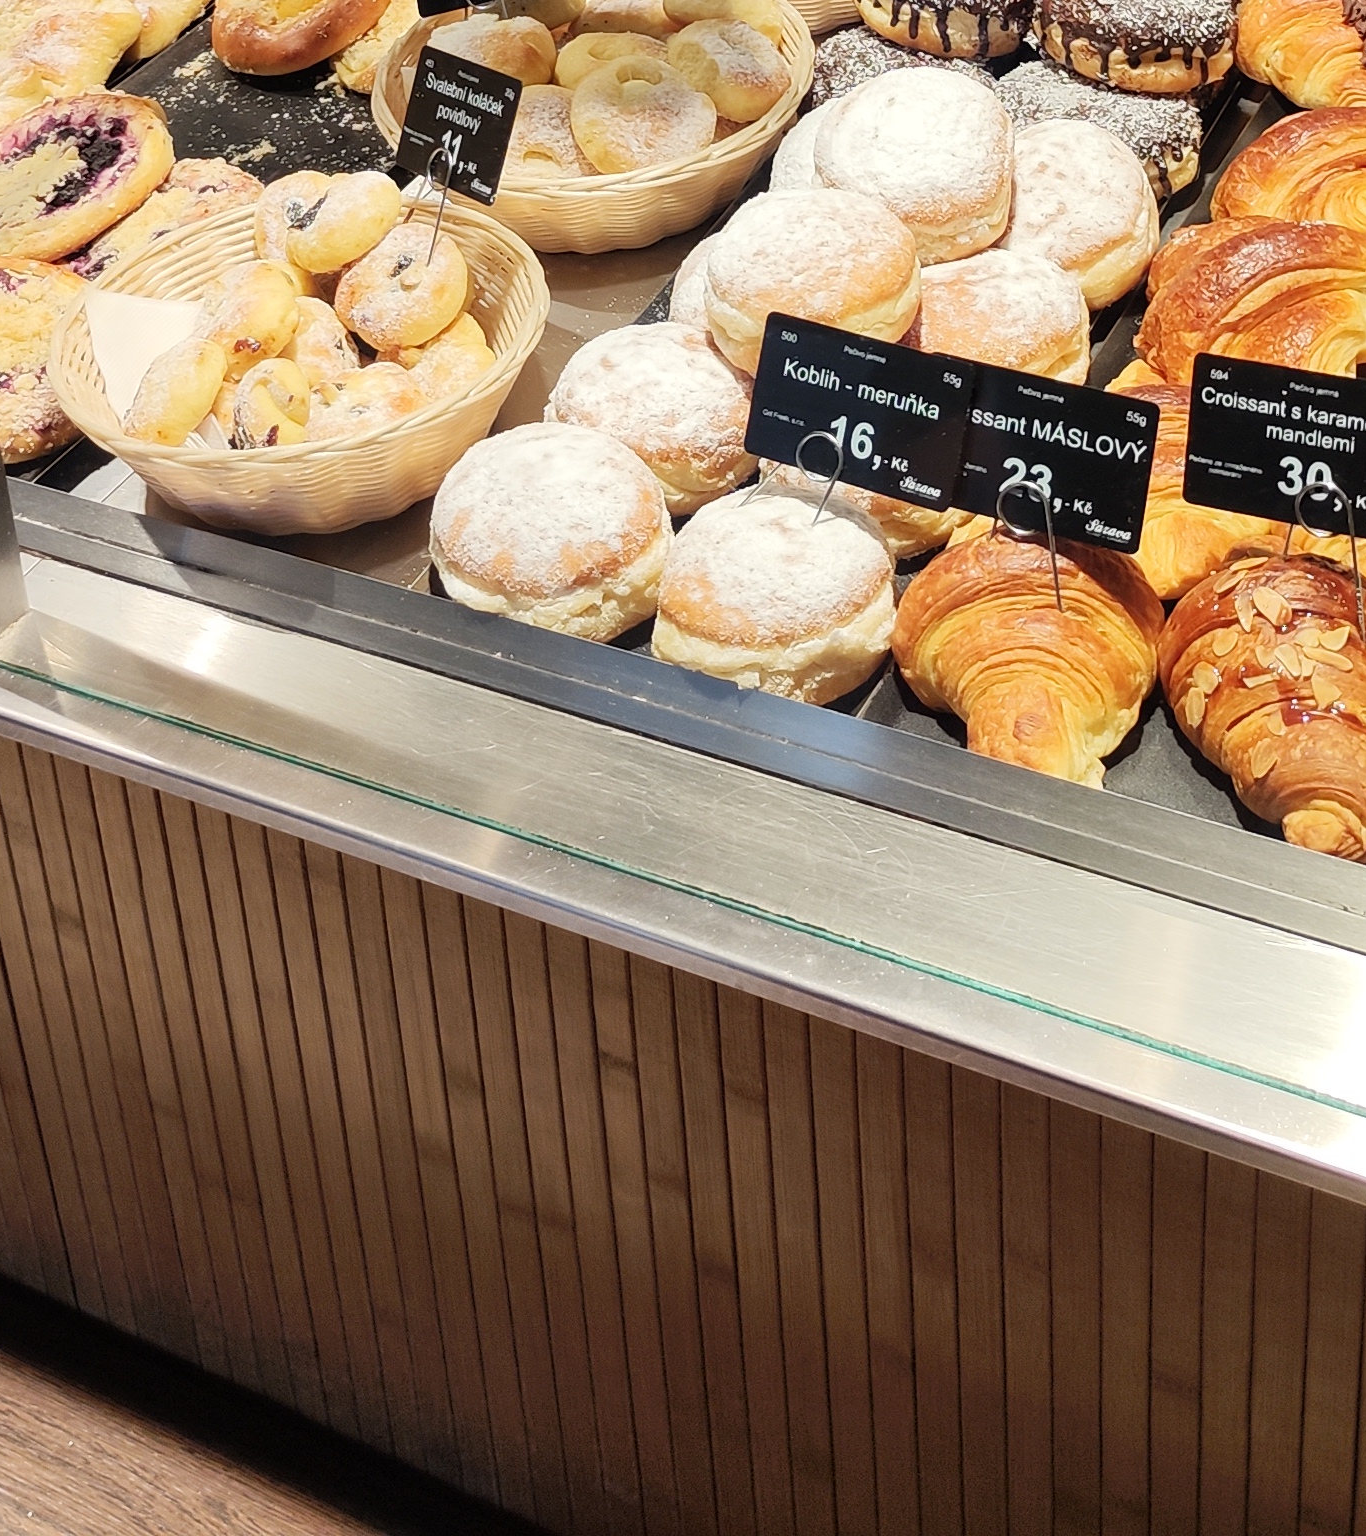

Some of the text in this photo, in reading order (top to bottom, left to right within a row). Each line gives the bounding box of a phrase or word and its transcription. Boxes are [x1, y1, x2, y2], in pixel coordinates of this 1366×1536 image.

[425, 72, 505, 117] Svatební koláček
[436, 104, 482, 136] povidlový
[781, 330, 963, 388] 500 55g
[1210, 368, 1229, 381] 594
[783, 358, 940, 421] Koblih meruňka
[1201, 386, 1287, 419] Croissant
[1291, 405, 1301, 419] s
[1126, 410, 1147, 428] 55g
[968, 408, 1147, 464] ssant MÁSLOVÝ
[1266, 424, 1356, 454] mandlemi
[891, 456, 909, 473] Kč
[1073, 498, 1093, 516] Kč
